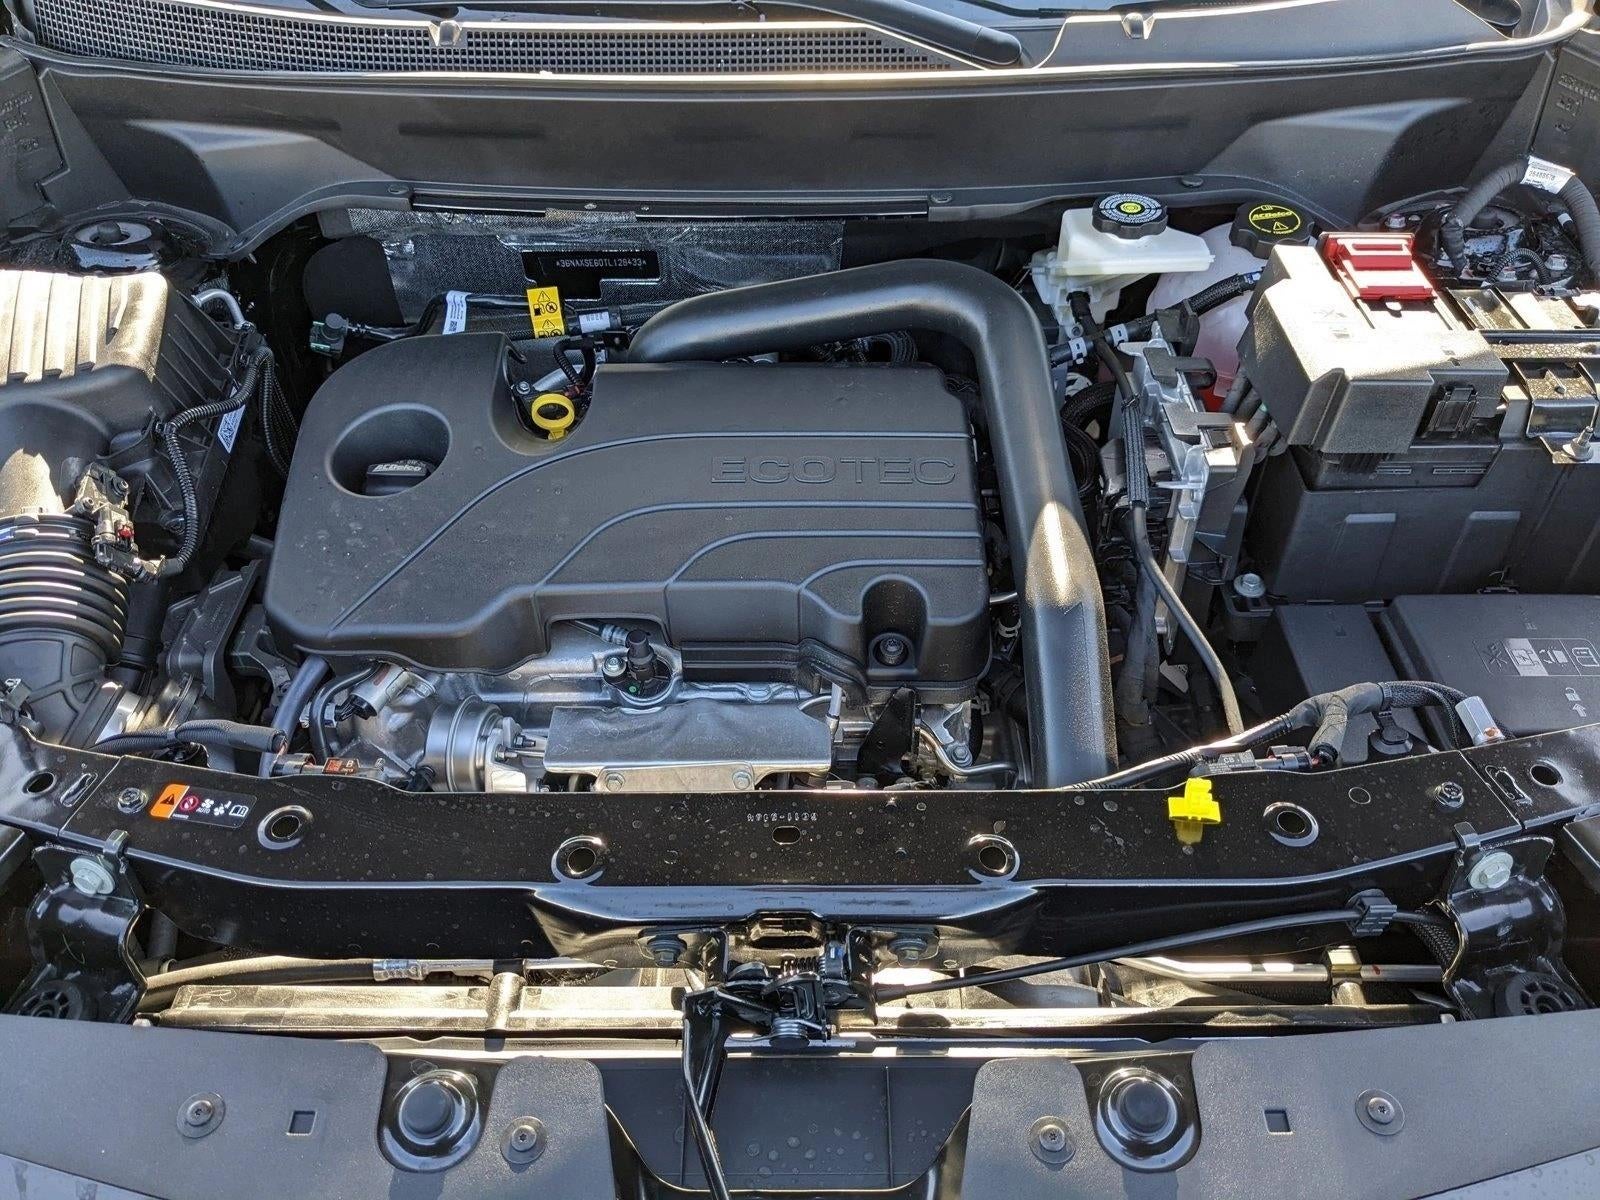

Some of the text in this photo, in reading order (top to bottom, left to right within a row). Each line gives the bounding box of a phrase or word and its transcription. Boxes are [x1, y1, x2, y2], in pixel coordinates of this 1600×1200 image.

[1251, 211, 1293, 222] ACDelco
[371, 464, 422, 473] ACDelco
[711, 456, 956, 485] ECOTEC
